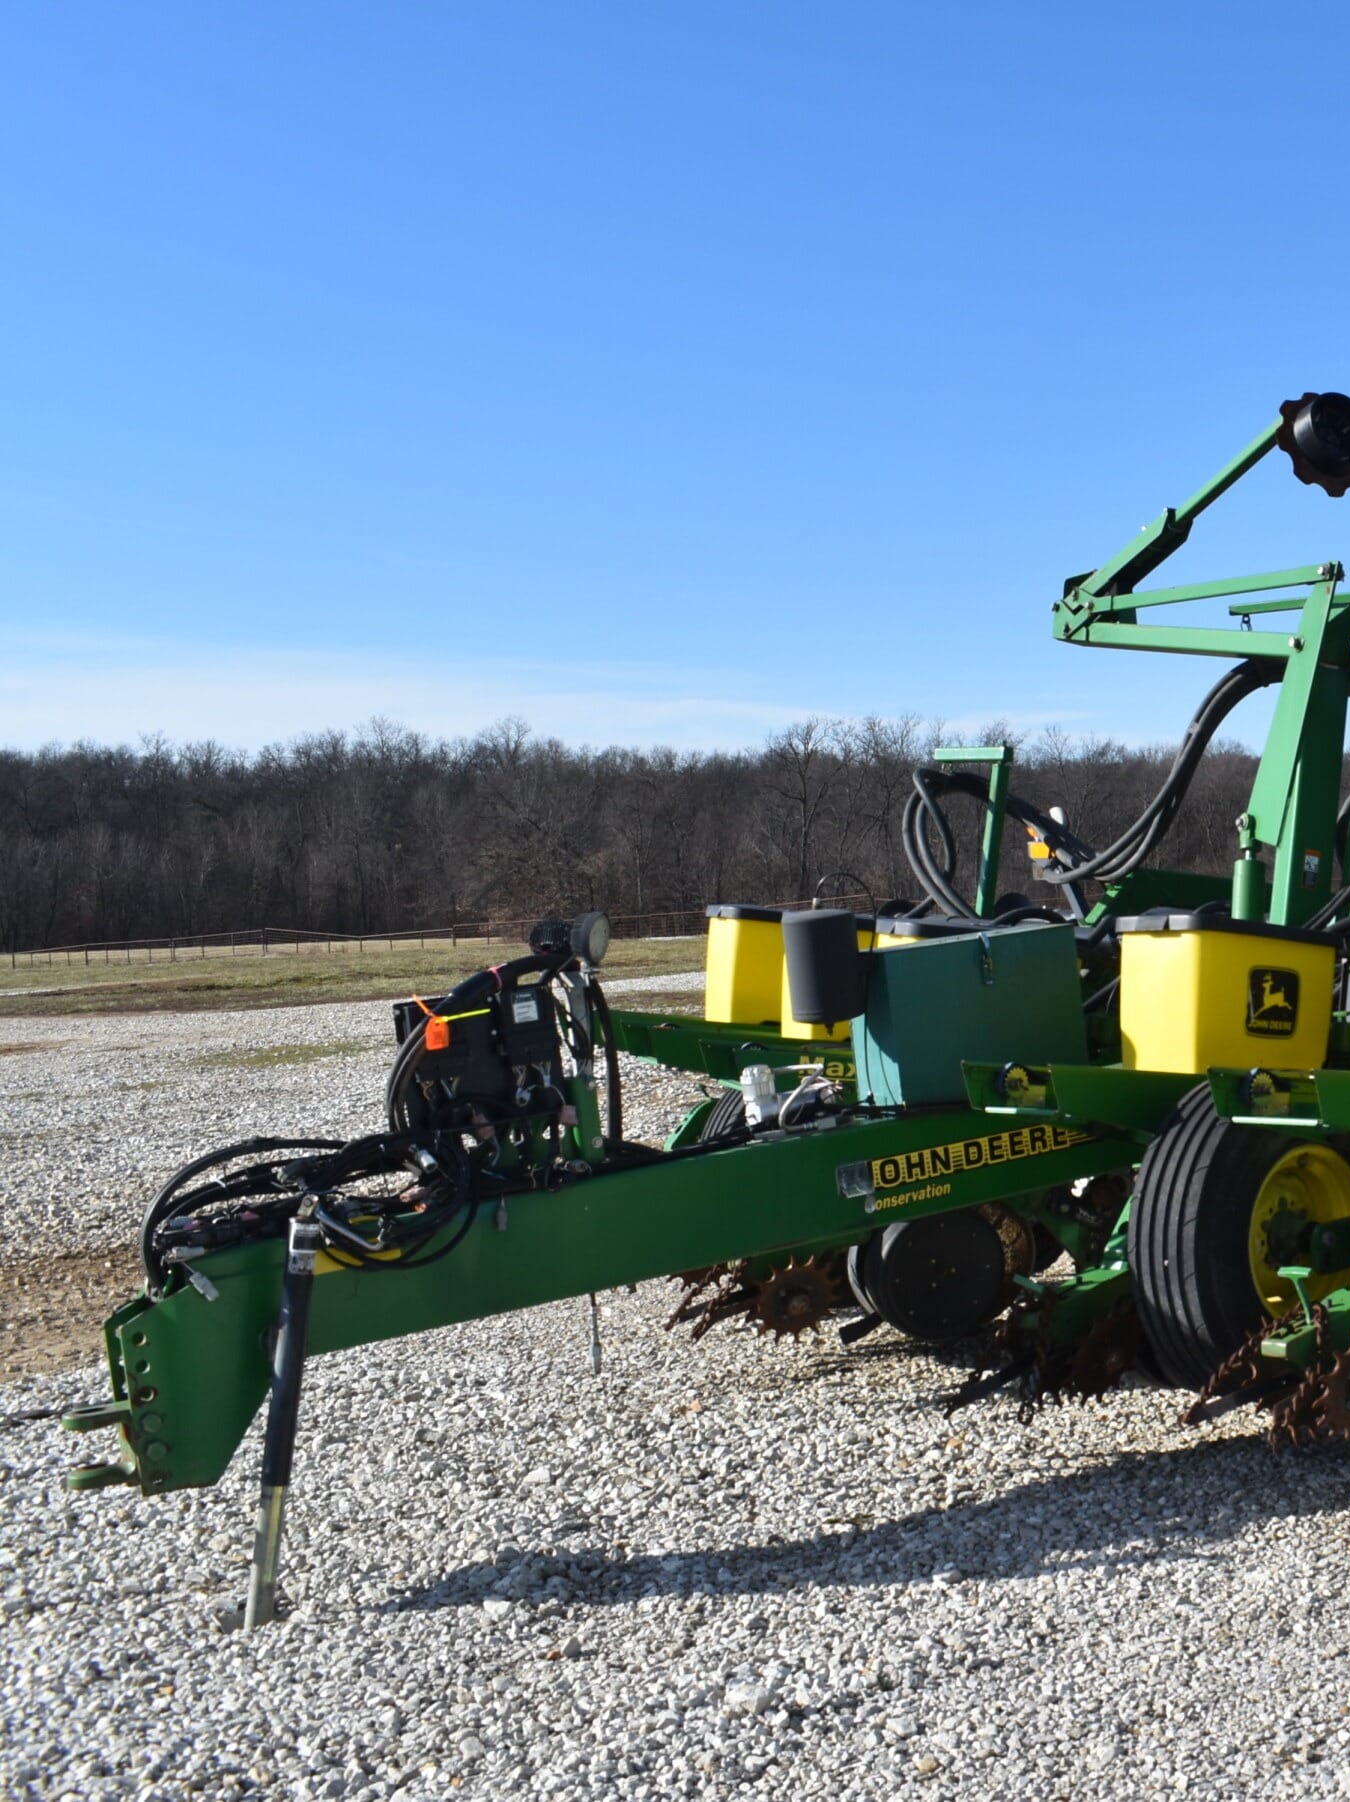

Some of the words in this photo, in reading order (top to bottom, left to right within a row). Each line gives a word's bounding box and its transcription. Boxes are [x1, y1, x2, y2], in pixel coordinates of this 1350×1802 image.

[866, 1145, 952, 1187] OHN
[962, 1126, 1070, 1169] DEERE
[870, 1182, 952, 1211] onservation
